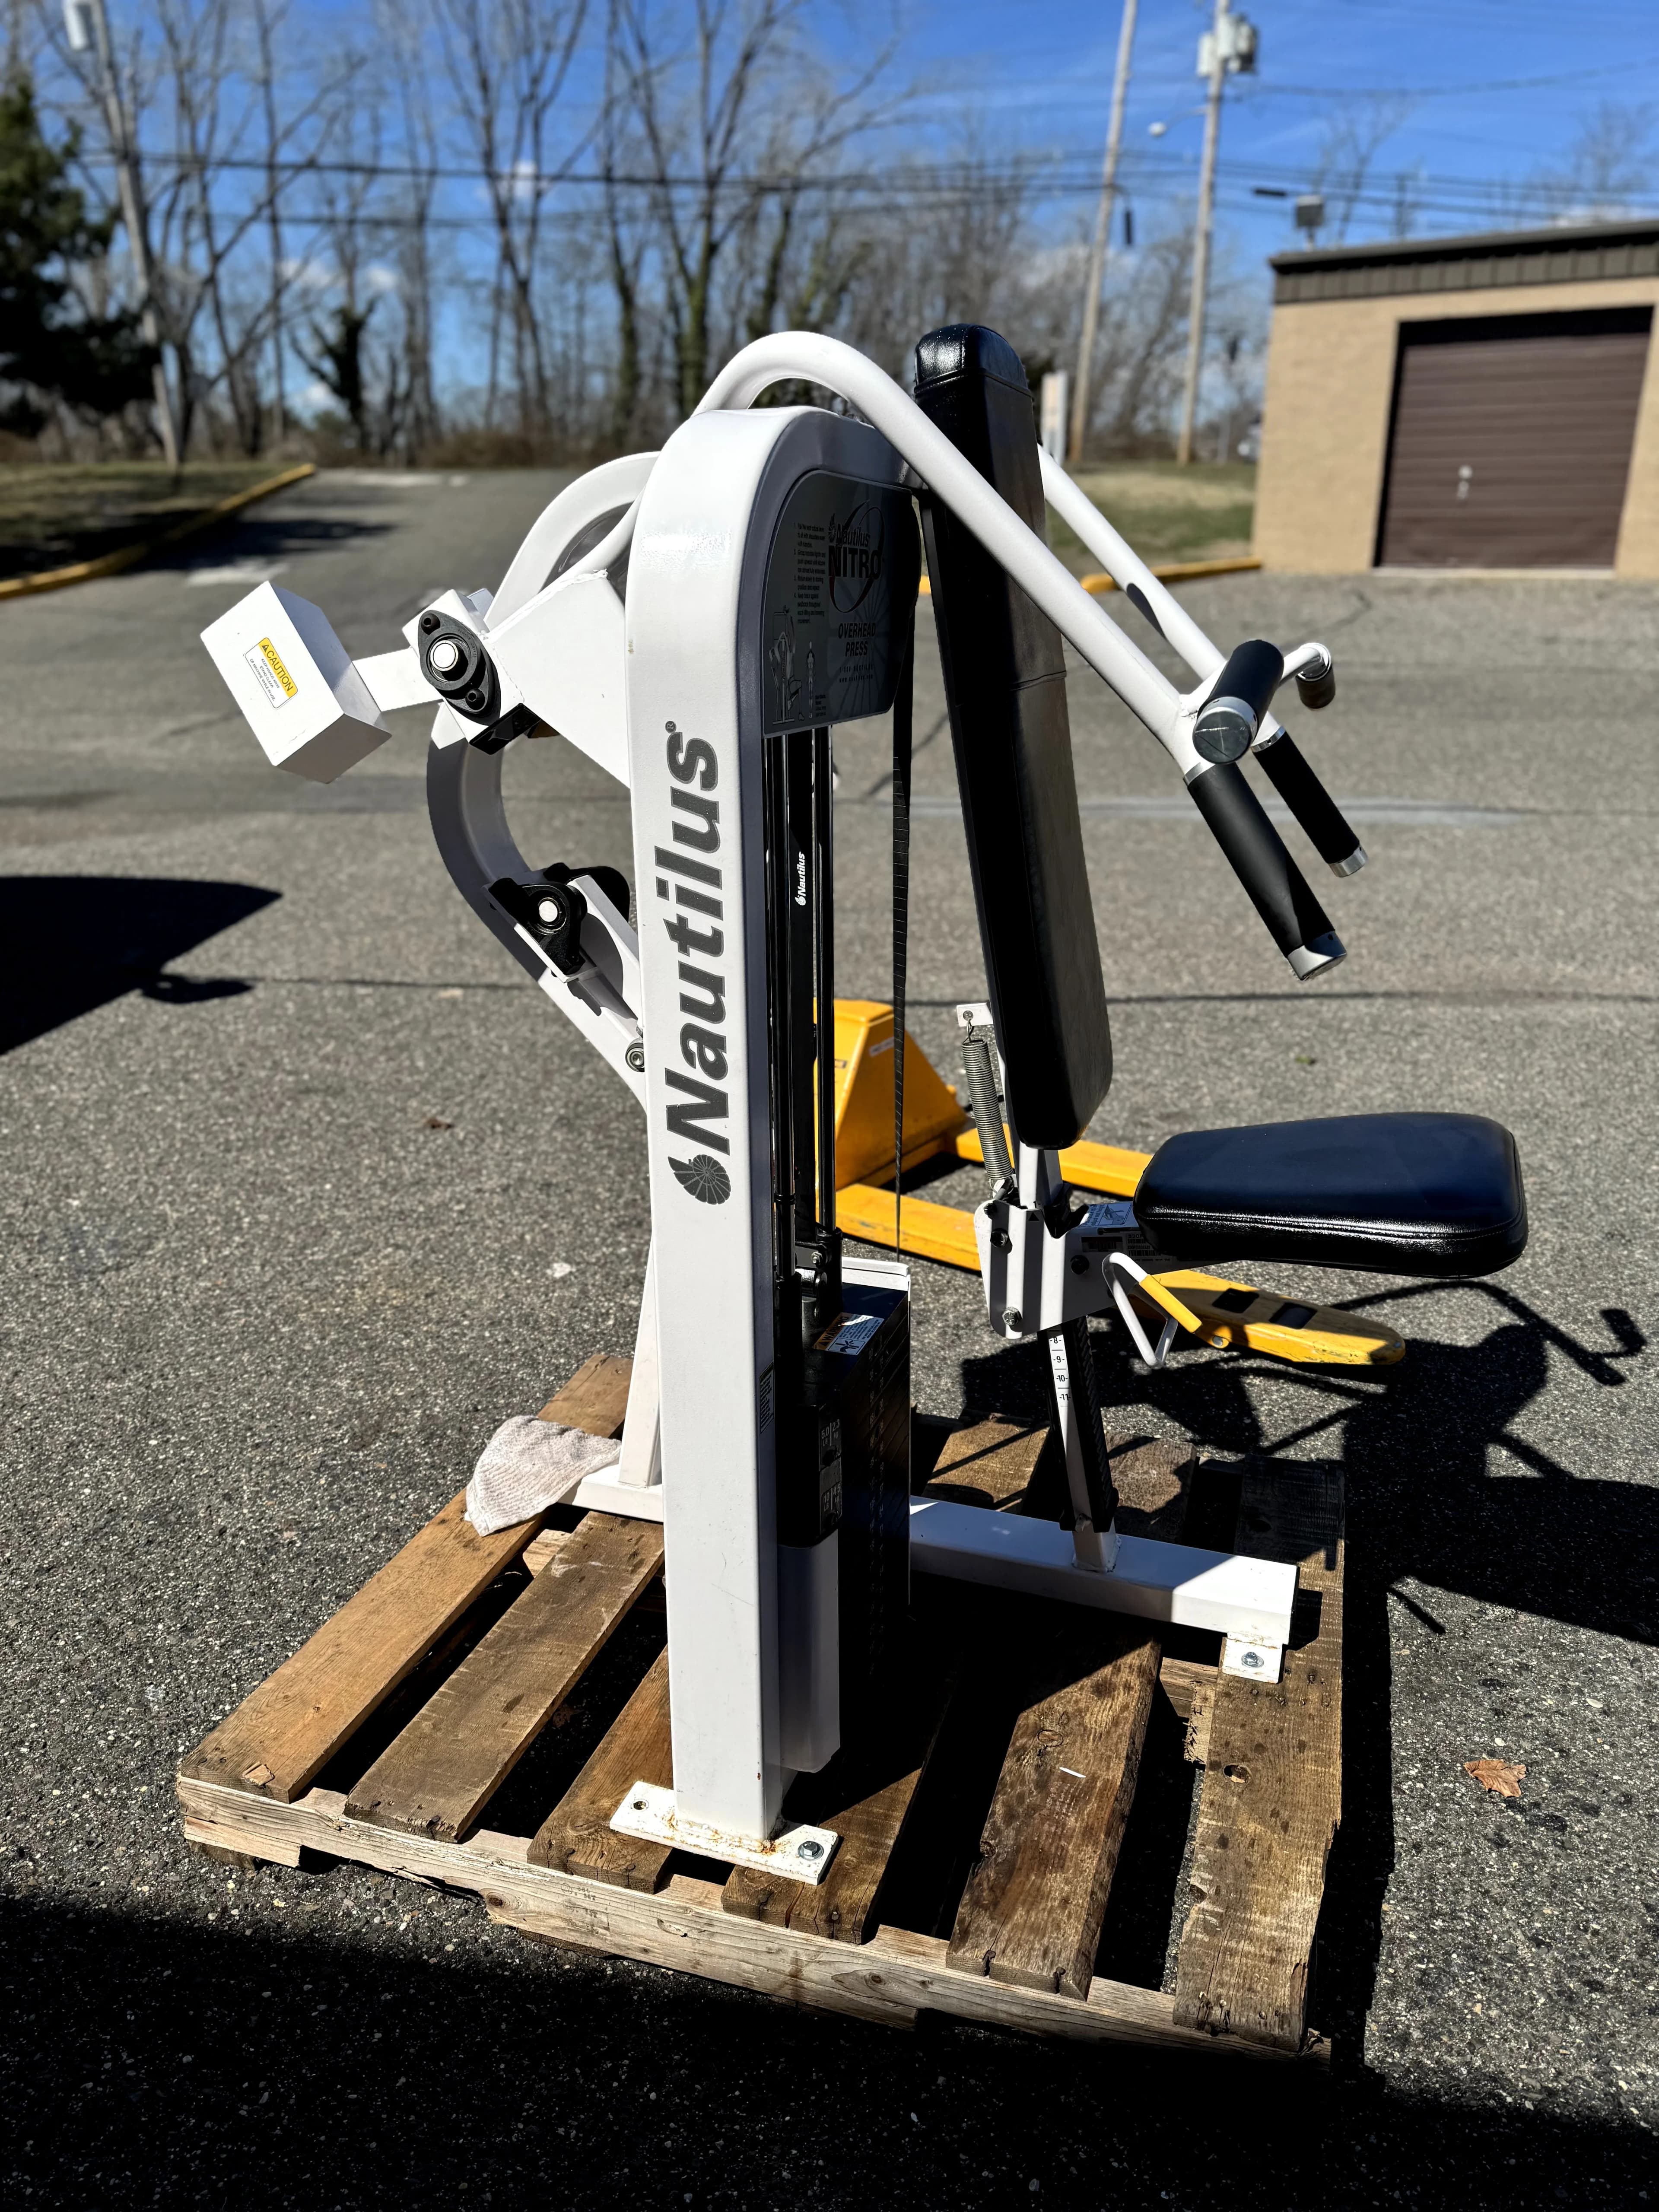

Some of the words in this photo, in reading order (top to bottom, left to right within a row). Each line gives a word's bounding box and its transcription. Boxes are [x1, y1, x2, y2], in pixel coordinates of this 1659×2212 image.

[837, 523, 871, 547] Nautilus
[828, 545, 882, 579] NITRO
[838, 623, 876, 639] OVERHEAD
[845, 641, 868, 656] PRESS
[266, 650, 293, 691] CAUTION
[797, 851, 806, 896] Nautilus
[655, 731, 730, 1156] Nautilus
